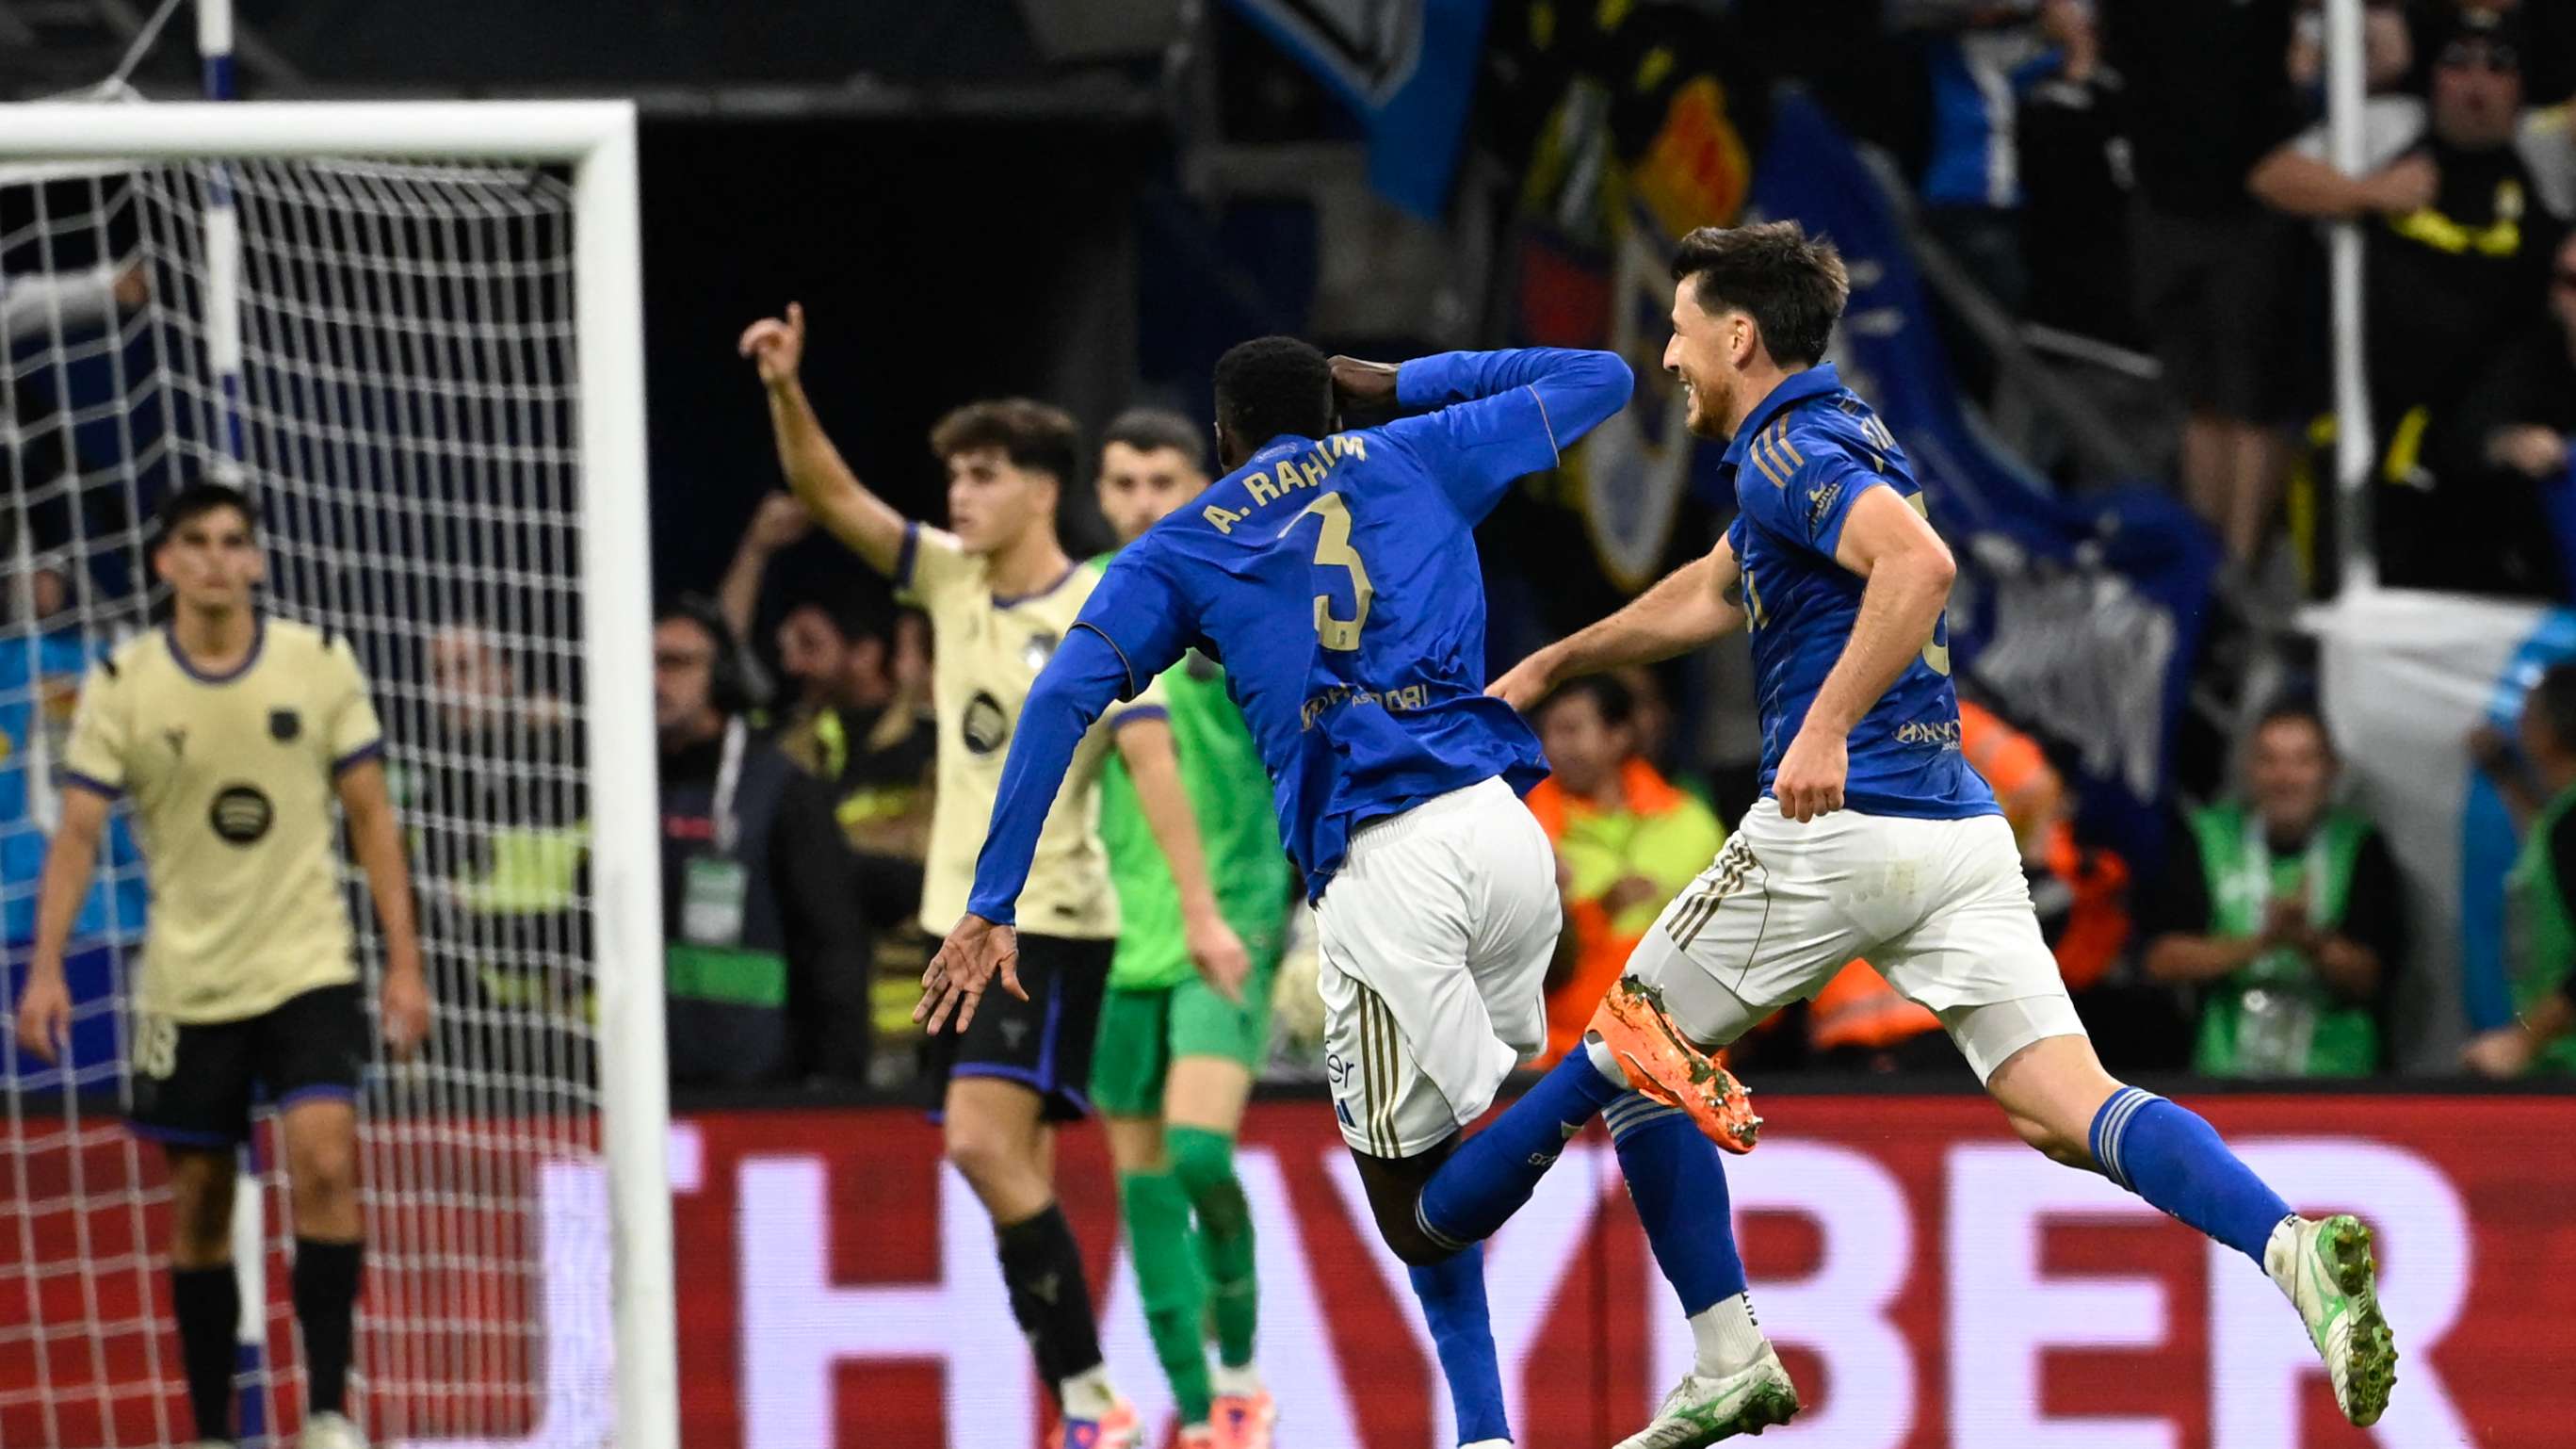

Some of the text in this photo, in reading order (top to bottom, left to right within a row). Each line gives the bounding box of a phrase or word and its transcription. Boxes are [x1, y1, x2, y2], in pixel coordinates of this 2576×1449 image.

[1203, 505, 1251, 534] A.
[1242, 436, 1369, 507] RAHIM
[1276, 491, 1374, 651] 3
